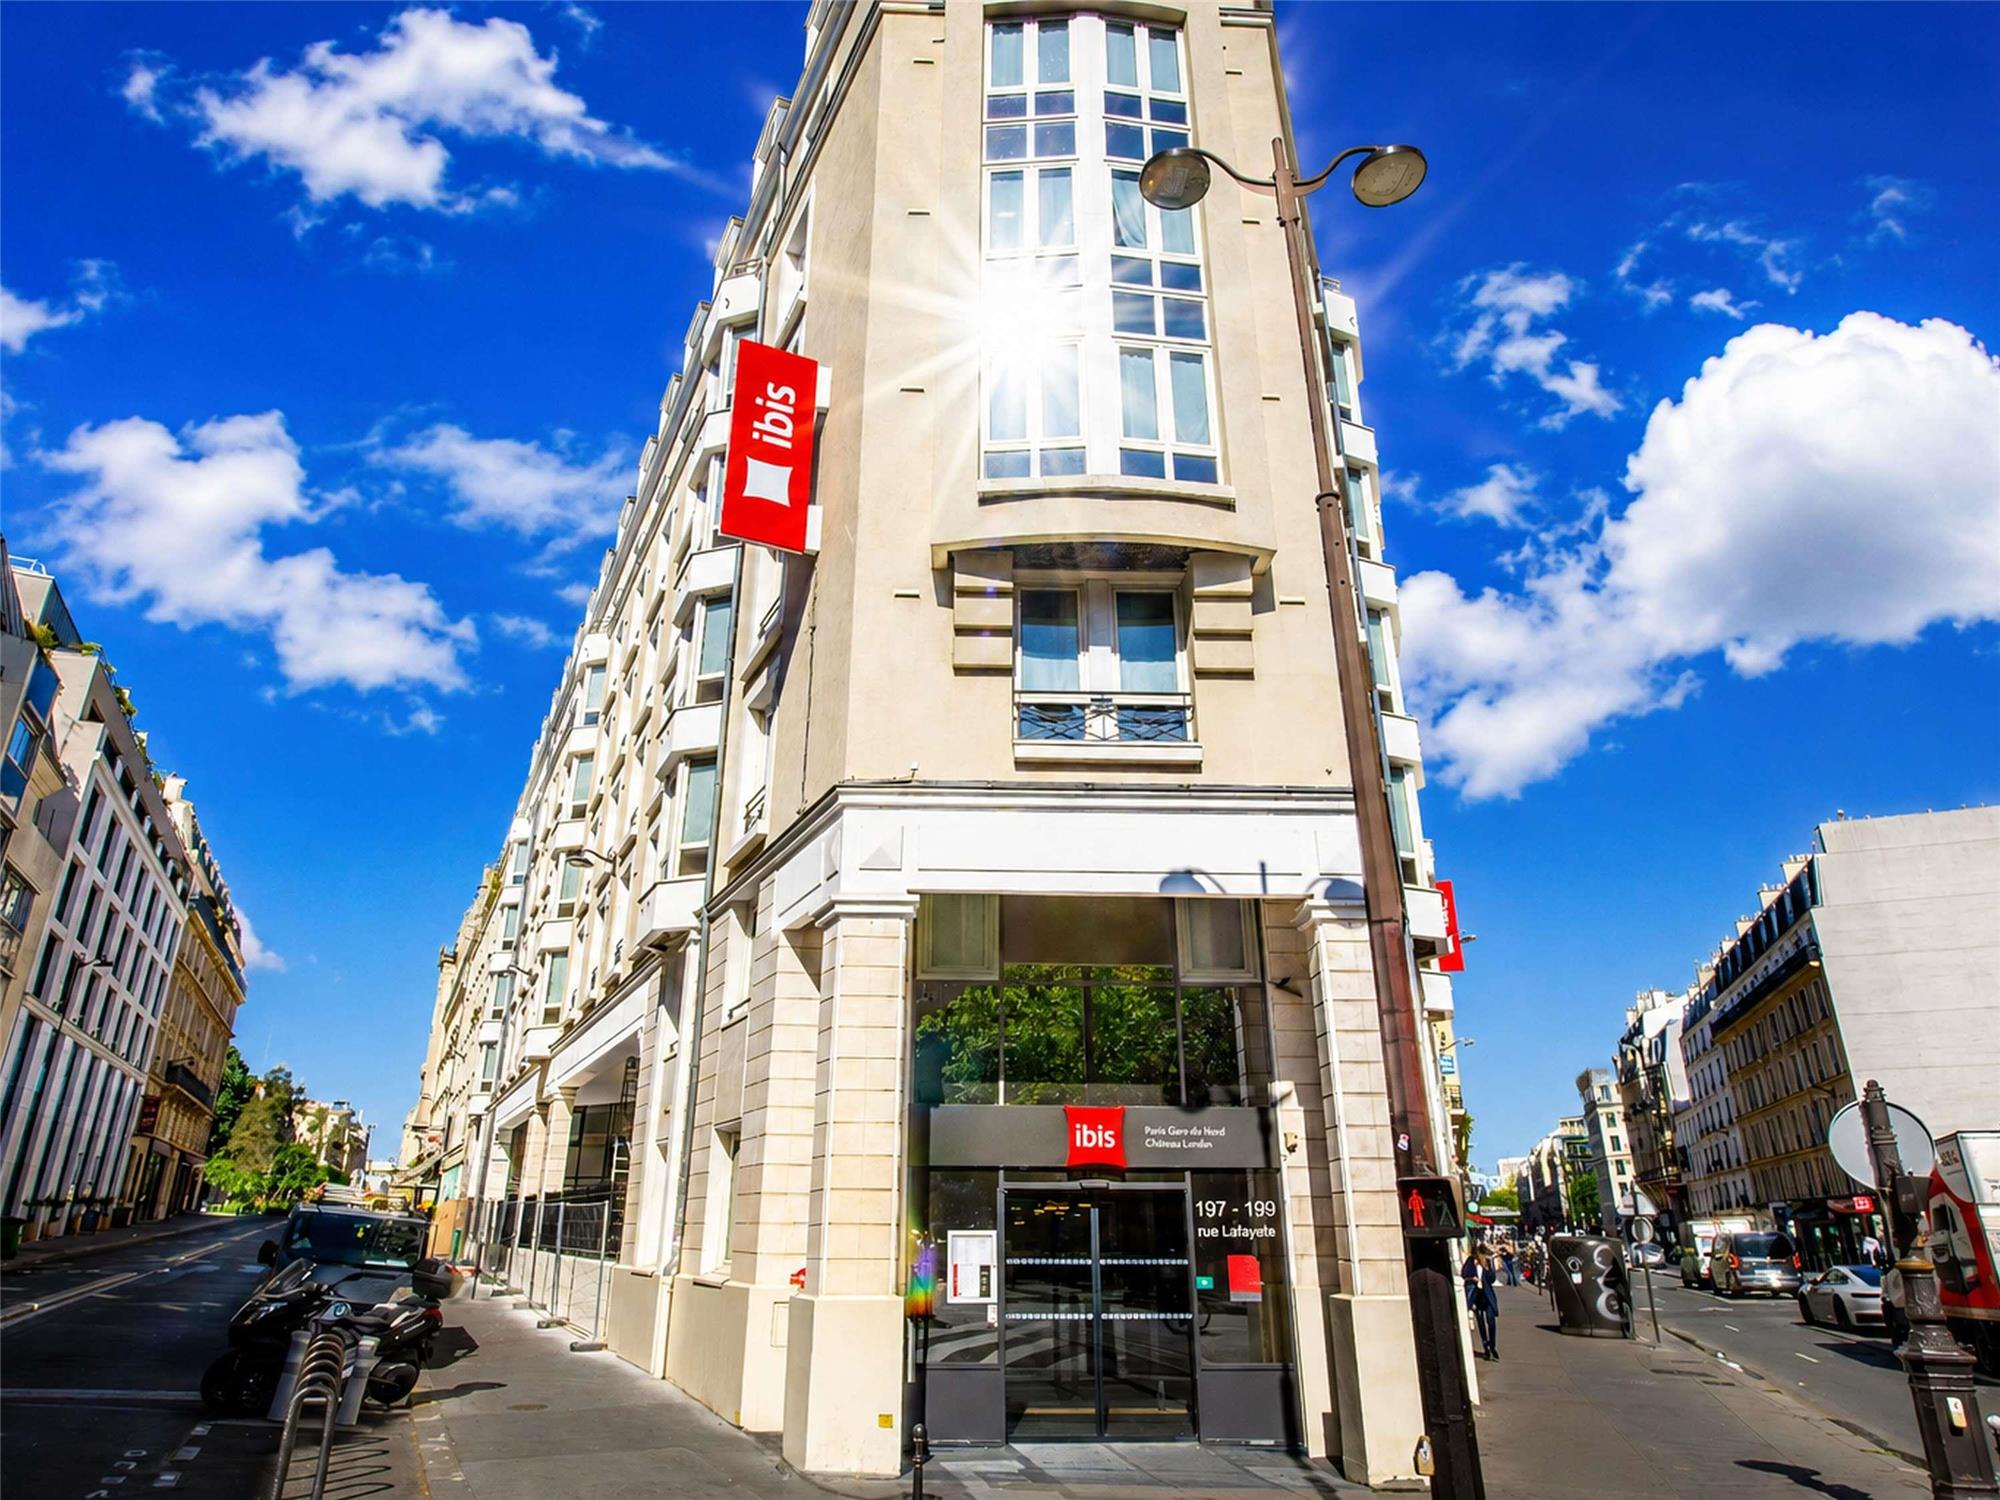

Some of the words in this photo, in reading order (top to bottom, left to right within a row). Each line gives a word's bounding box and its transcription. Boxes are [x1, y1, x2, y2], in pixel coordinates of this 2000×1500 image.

[752, 381, 796, 450] ibis
[1075, 1123, 1116, 1149] ibis
[1195, 1200, 1227, 1218] 197
[1244, 1200, 1276, 1218] 199
[1197, 1227, 1219, 1238] rue
